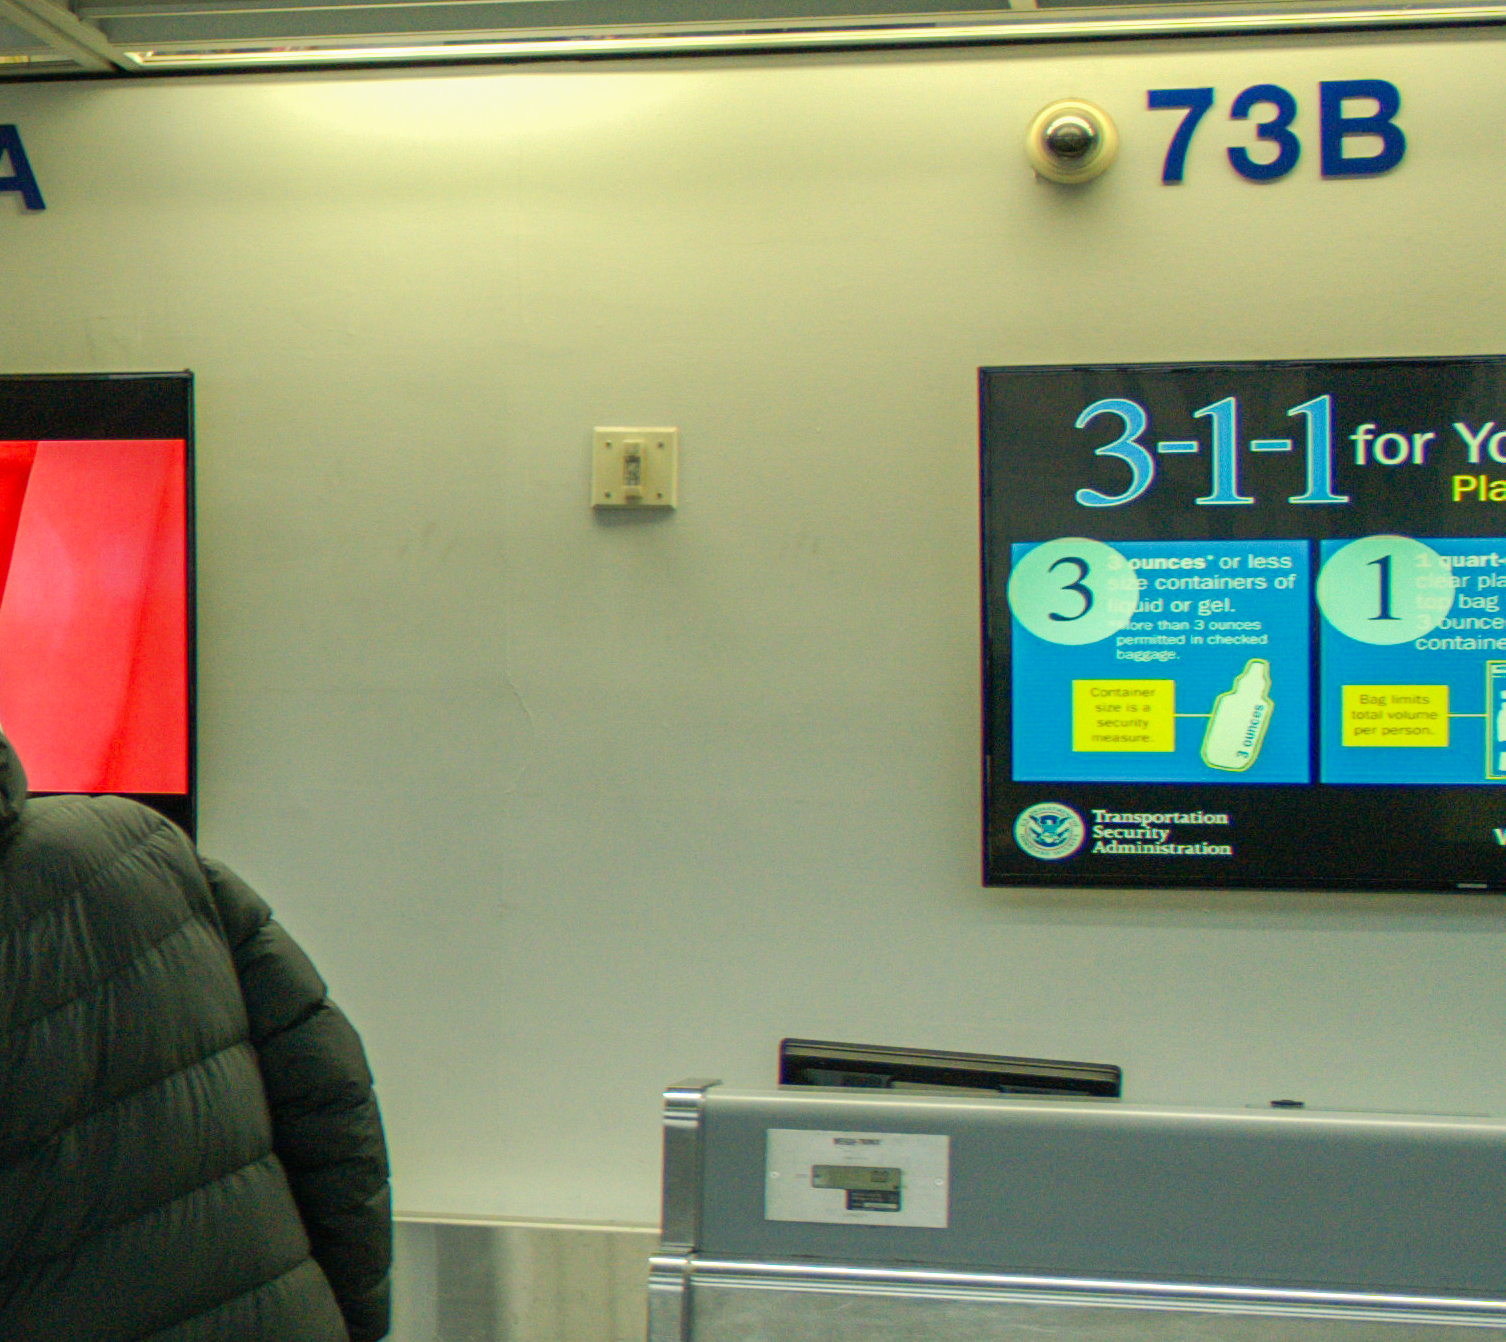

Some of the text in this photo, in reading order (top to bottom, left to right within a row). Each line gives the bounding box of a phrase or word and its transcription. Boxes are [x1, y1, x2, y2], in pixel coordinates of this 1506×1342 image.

[1147, 79, 1407, 185] 73B
[1074, 394, 1435, 508] 3-1-1 for
[1219, 554, 1292, 569] or less
[1048, 557, 1094, 622] 3
[1155, 574, 1297, 590] containers of
[1367, 555, 1402, 621] 1
[1170, 599, 1191, 612] or
[1459, 594, 1500, 612] bag
[1209, 621, 1261, 630] ounces
[1207, 634, 1268, 645] checked
[1091, 809, 1230, 827] Transportation
[1092, 825, 1170, 842] Security
[1092, 840, 1233, 855] Administration
